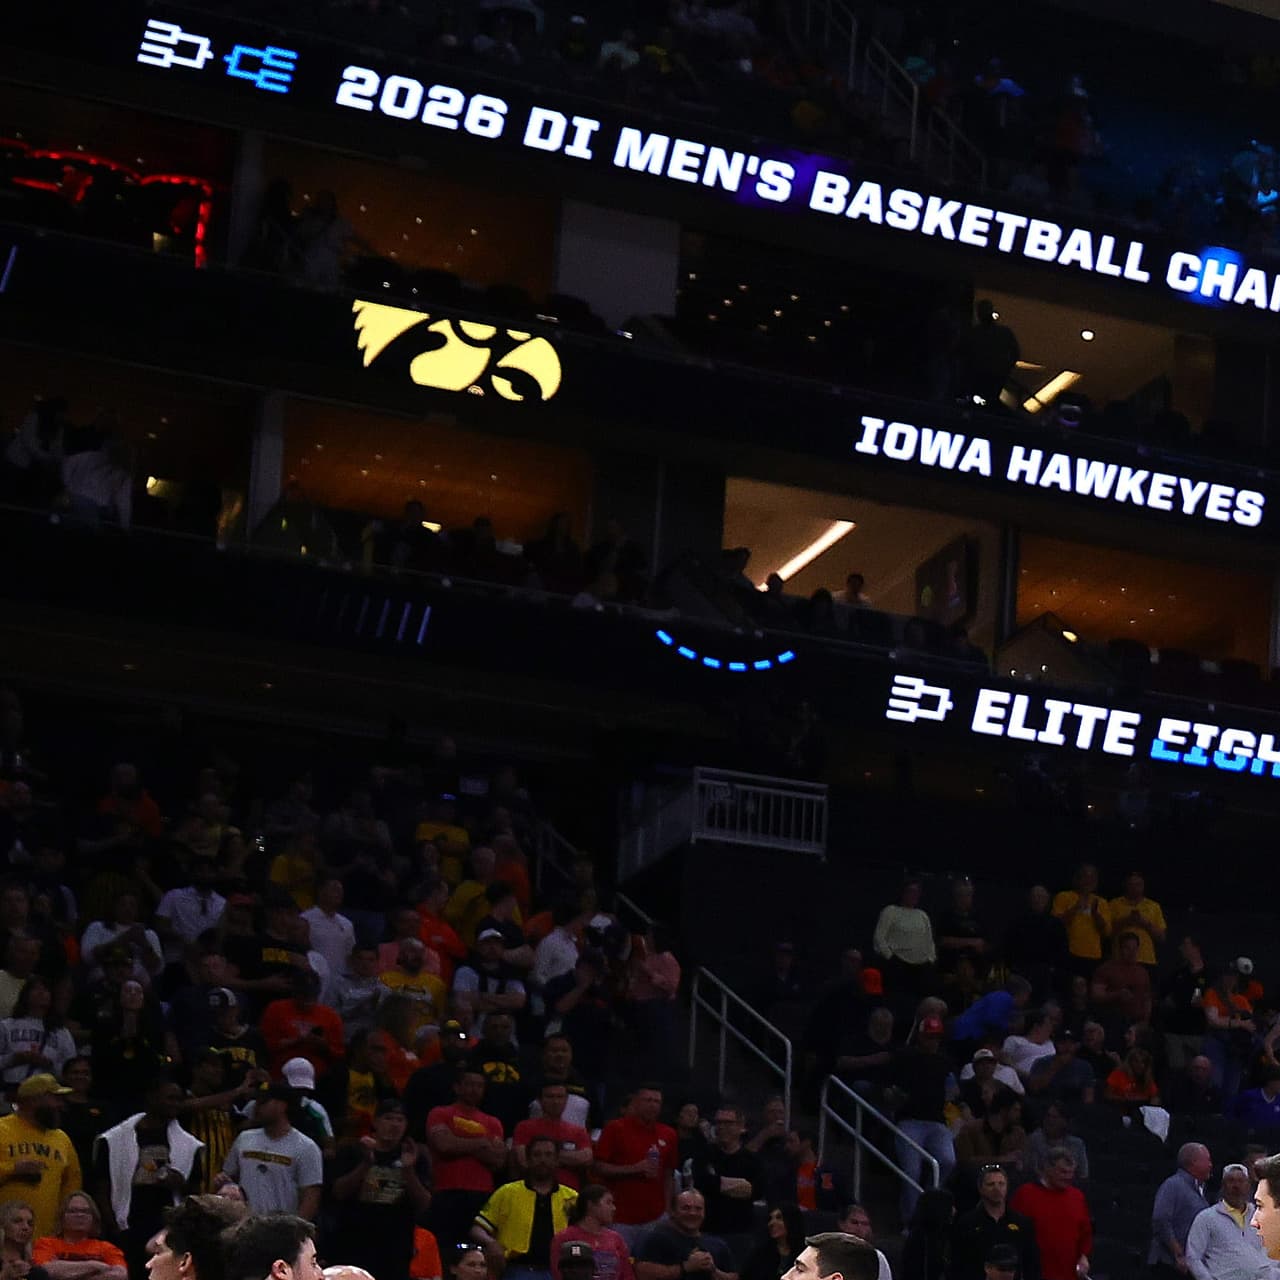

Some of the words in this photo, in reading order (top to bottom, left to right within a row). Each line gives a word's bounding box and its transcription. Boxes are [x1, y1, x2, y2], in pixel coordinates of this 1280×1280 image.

[336, 66, 508, 138] 2026
[523, 107, 600, 159] DI
[614, 127, 795, 202] MEN'S
[809, 171, 1150, 282] BASKETBALL
[855, 416, 991, 476] IOWA
[1007, 446, 1265, 526] HAWKEYES
[972, 689, 1141, 755] ELITE
[8, 1142, 62, 1161] IOWA
